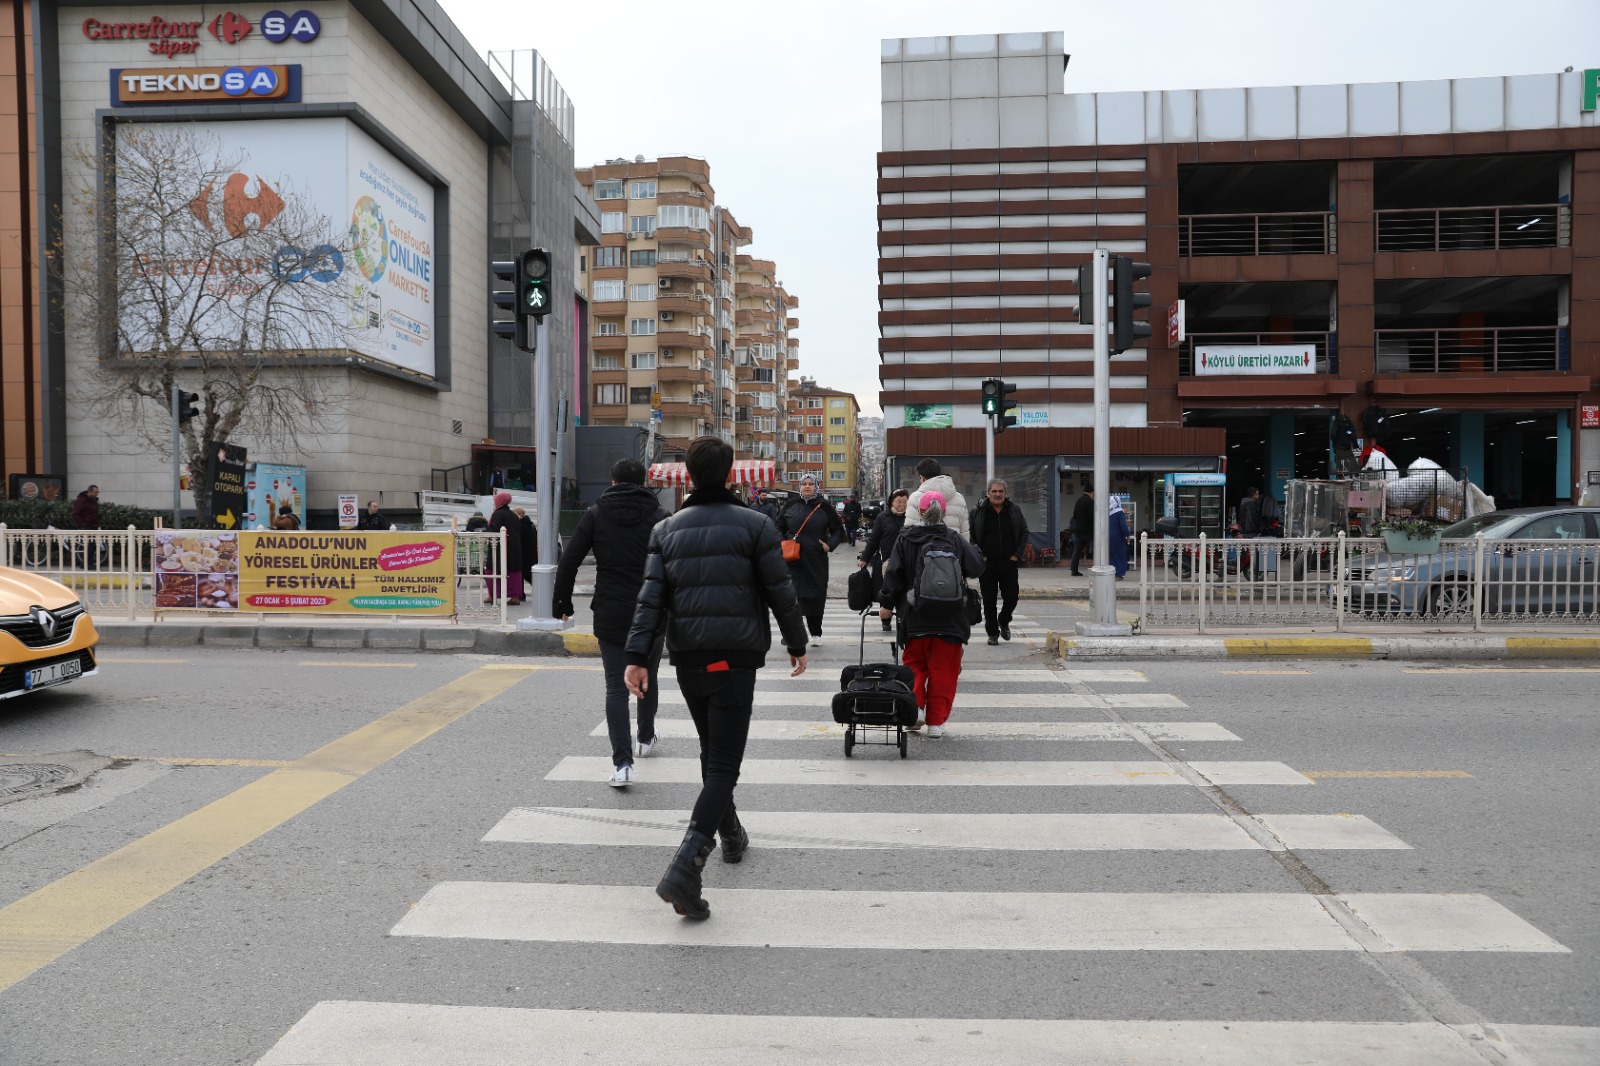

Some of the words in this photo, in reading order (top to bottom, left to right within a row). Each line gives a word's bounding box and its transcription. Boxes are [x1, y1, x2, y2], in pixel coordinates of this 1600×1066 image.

[82, 16, 200, 40] Carrefour
[148, 38, 200, 58] süper
[122, 71, 273, 93] TEKNOSA
[389, 240, 430, 282] ONLINE
[1207, 354, 1235, 368] KÖYLÜ
[1237, 353, 1271, 367] ÜRETİCİ
[1273, 355, 1303, 367] PAZARI
[1023, 411, 1048, 419] YALOVA
[219, 471, 241, 484] KAPALI
[214, 482, 244, 495] OTOPARK
[254, 536, 367, 551] ANADOLU'NUN
[244, 552, 309, 569] YÖRESEL
[310, 553, 378, 570] ÜRÜNLER
[265, 572, 356, 590] FESTİVALİ
[374, 575, 395, 583] TÜM
[397, 576, 445, 584] HALKIMIZ
[381, 584, 438, 594] DAVETLİDİR
[255, 596, 263, 605] 27
[264, 596, 280, 605] OCAK
[285, 597, 290, 605] 5
[290, 597, 309, 606] ŞUBAT
[310, 597, 327, 606] 2023
[32, 669, 42, 683] 77
[51, 665, 55, 678] T
[60, 660, 80, 676] 0050
